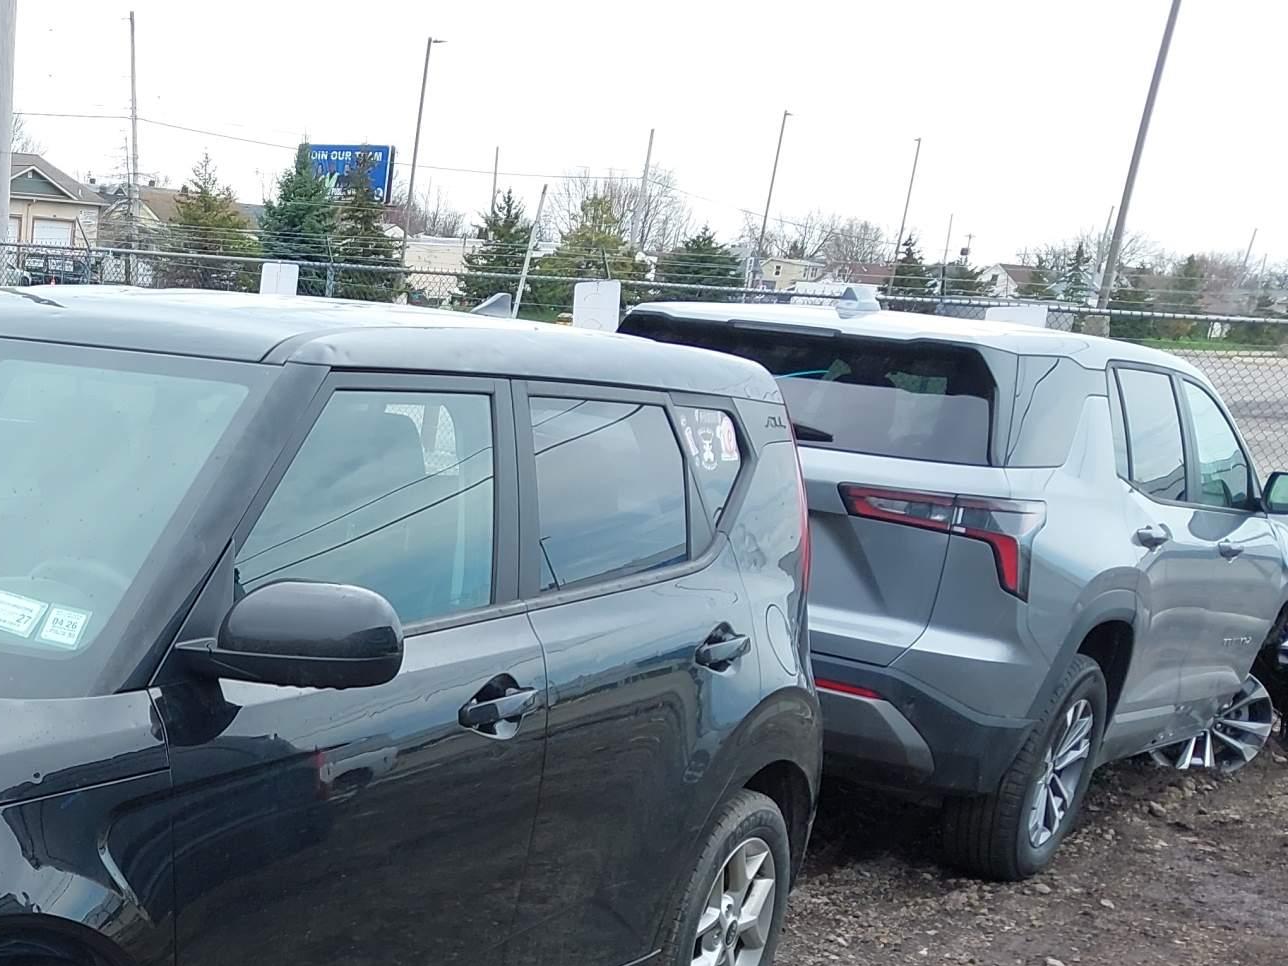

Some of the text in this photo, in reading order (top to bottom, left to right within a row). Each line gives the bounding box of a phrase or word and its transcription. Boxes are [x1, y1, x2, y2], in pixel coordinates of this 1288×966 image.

[331, 151, 352, 160] OUR
[355, 151, 382, 161] TAM
[15, 613, 32, 625] 27
